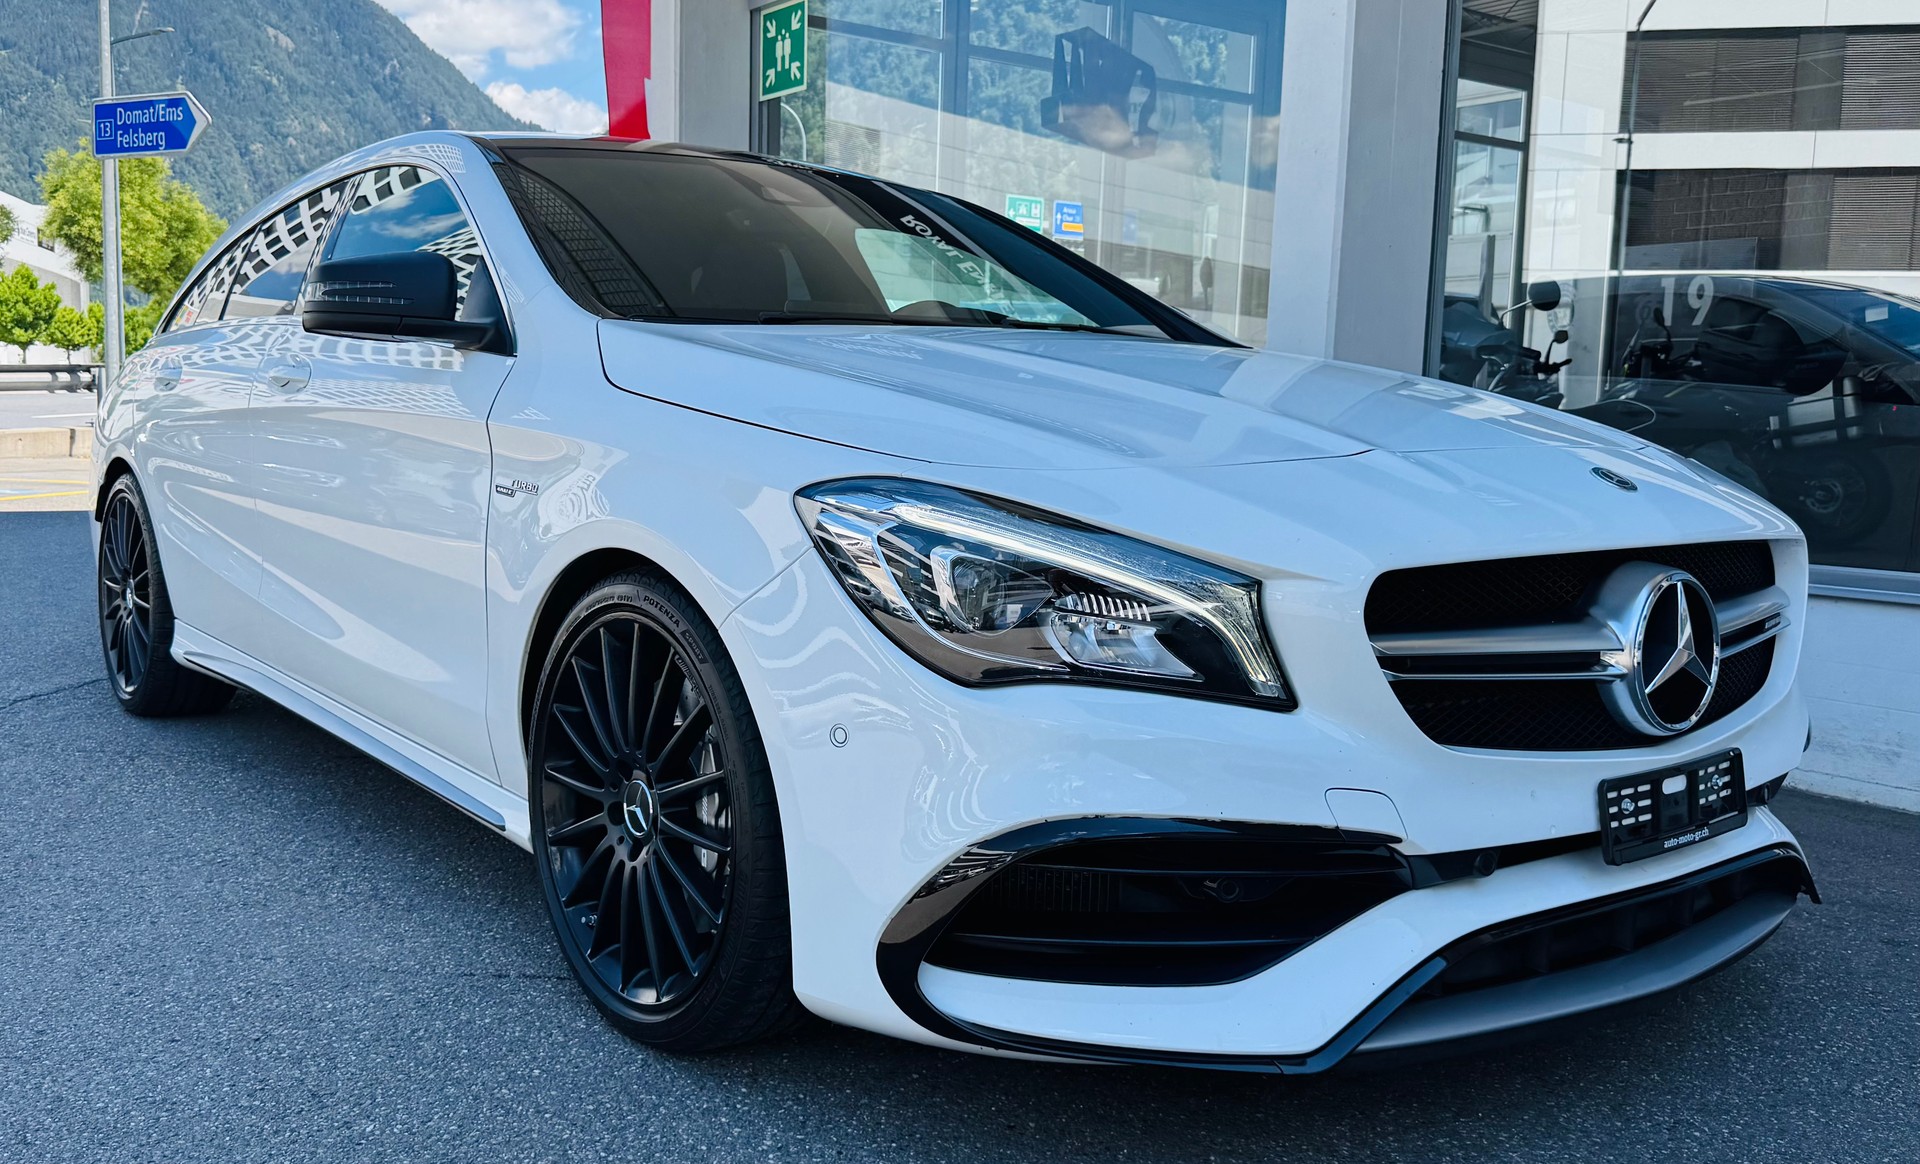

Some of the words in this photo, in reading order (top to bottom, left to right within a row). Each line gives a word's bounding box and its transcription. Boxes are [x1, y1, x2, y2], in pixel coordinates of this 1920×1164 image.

[117, 104, 183, 125] Domat/Ems
[100, 122, 111, 137] 13
[117, 128, 166, 150] Felsberg
[1661, 276, 1714, 327] 19
[511, 479, 540, 494] TURBO
[643, 595, 681, 628] POTENZA
[1663, 827, 1710, 849] auto-moto-gr.ch
